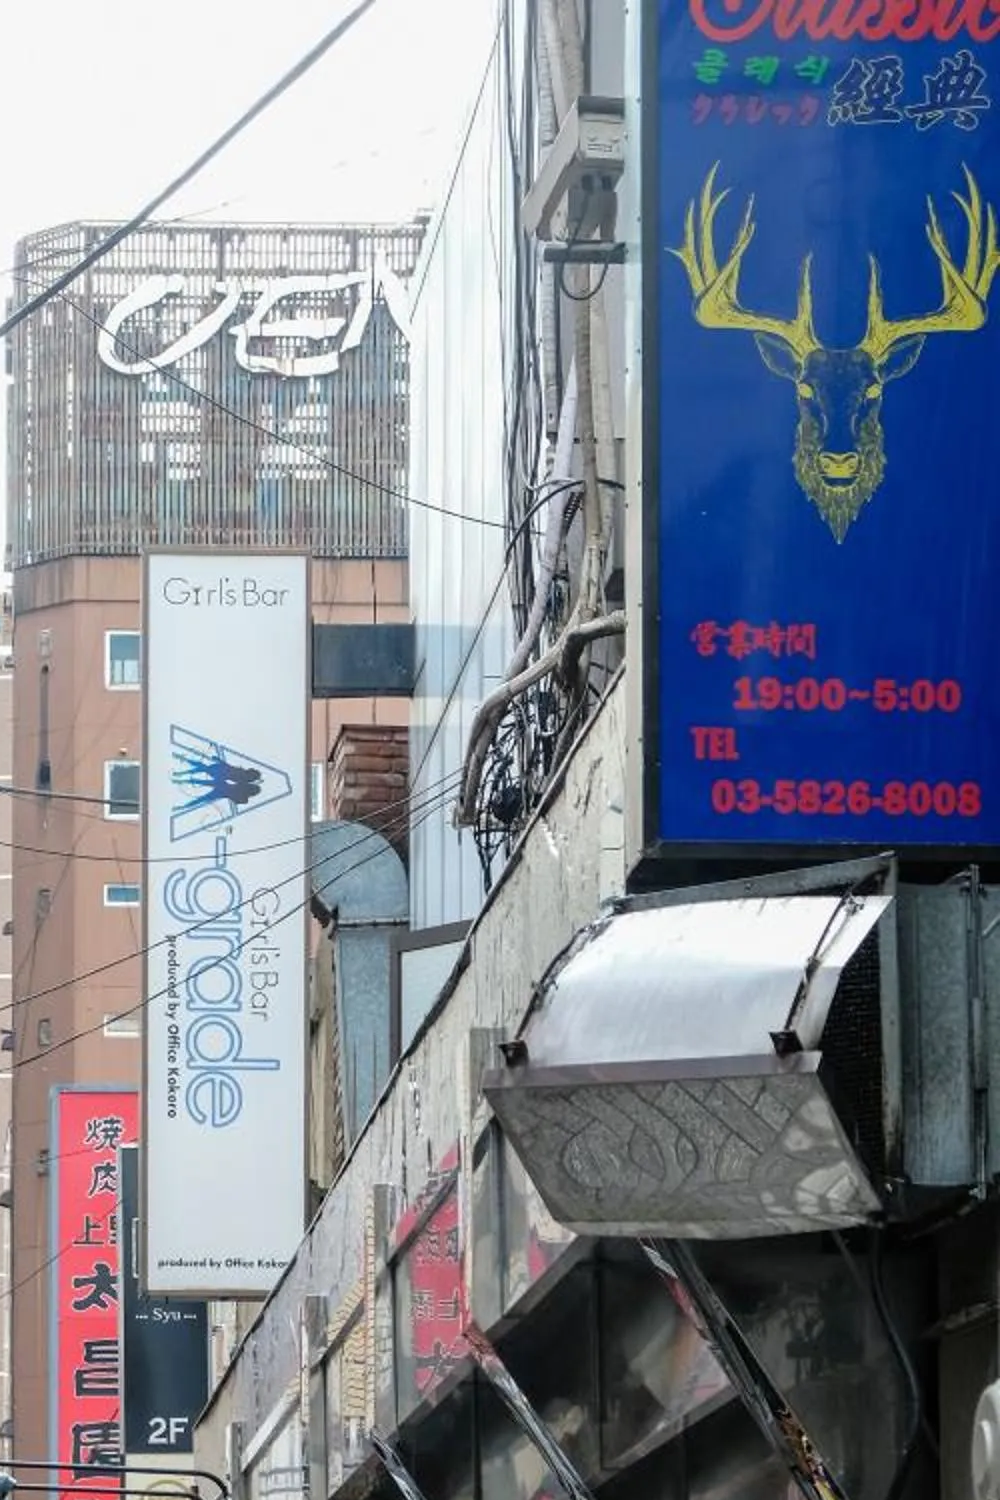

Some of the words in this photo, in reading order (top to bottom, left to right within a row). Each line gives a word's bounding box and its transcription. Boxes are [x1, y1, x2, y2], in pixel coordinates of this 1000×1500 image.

[243, 578, 290, 607] Bar
[690, 726, 740, 761] TEL
[711, 778, 982, 817] 03-5826-8008
[251, 970, 280, 1022] Bar
[167, 1024, 180, 1063] Office
[167, 1067, 181, 1119] Kokoro
[258, 1259, 290, 1269] Kokor
[147, 1416, 189, 1445] 2F
